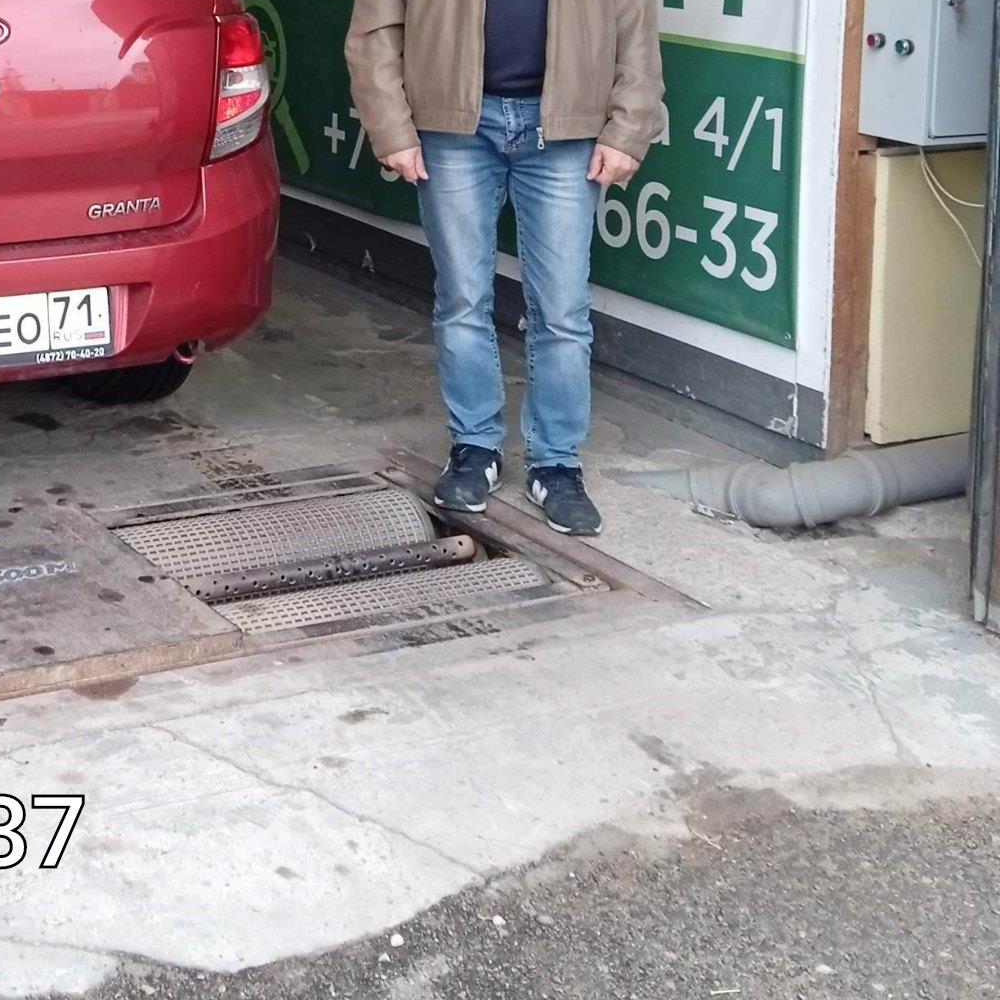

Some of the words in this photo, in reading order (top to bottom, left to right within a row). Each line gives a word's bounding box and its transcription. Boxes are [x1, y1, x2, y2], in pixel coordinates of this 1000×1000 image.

[693, 96, 783, 171] 4/1
[87, 196, 161, 219] GRANTA
[53, 294, 92, 330] 71
